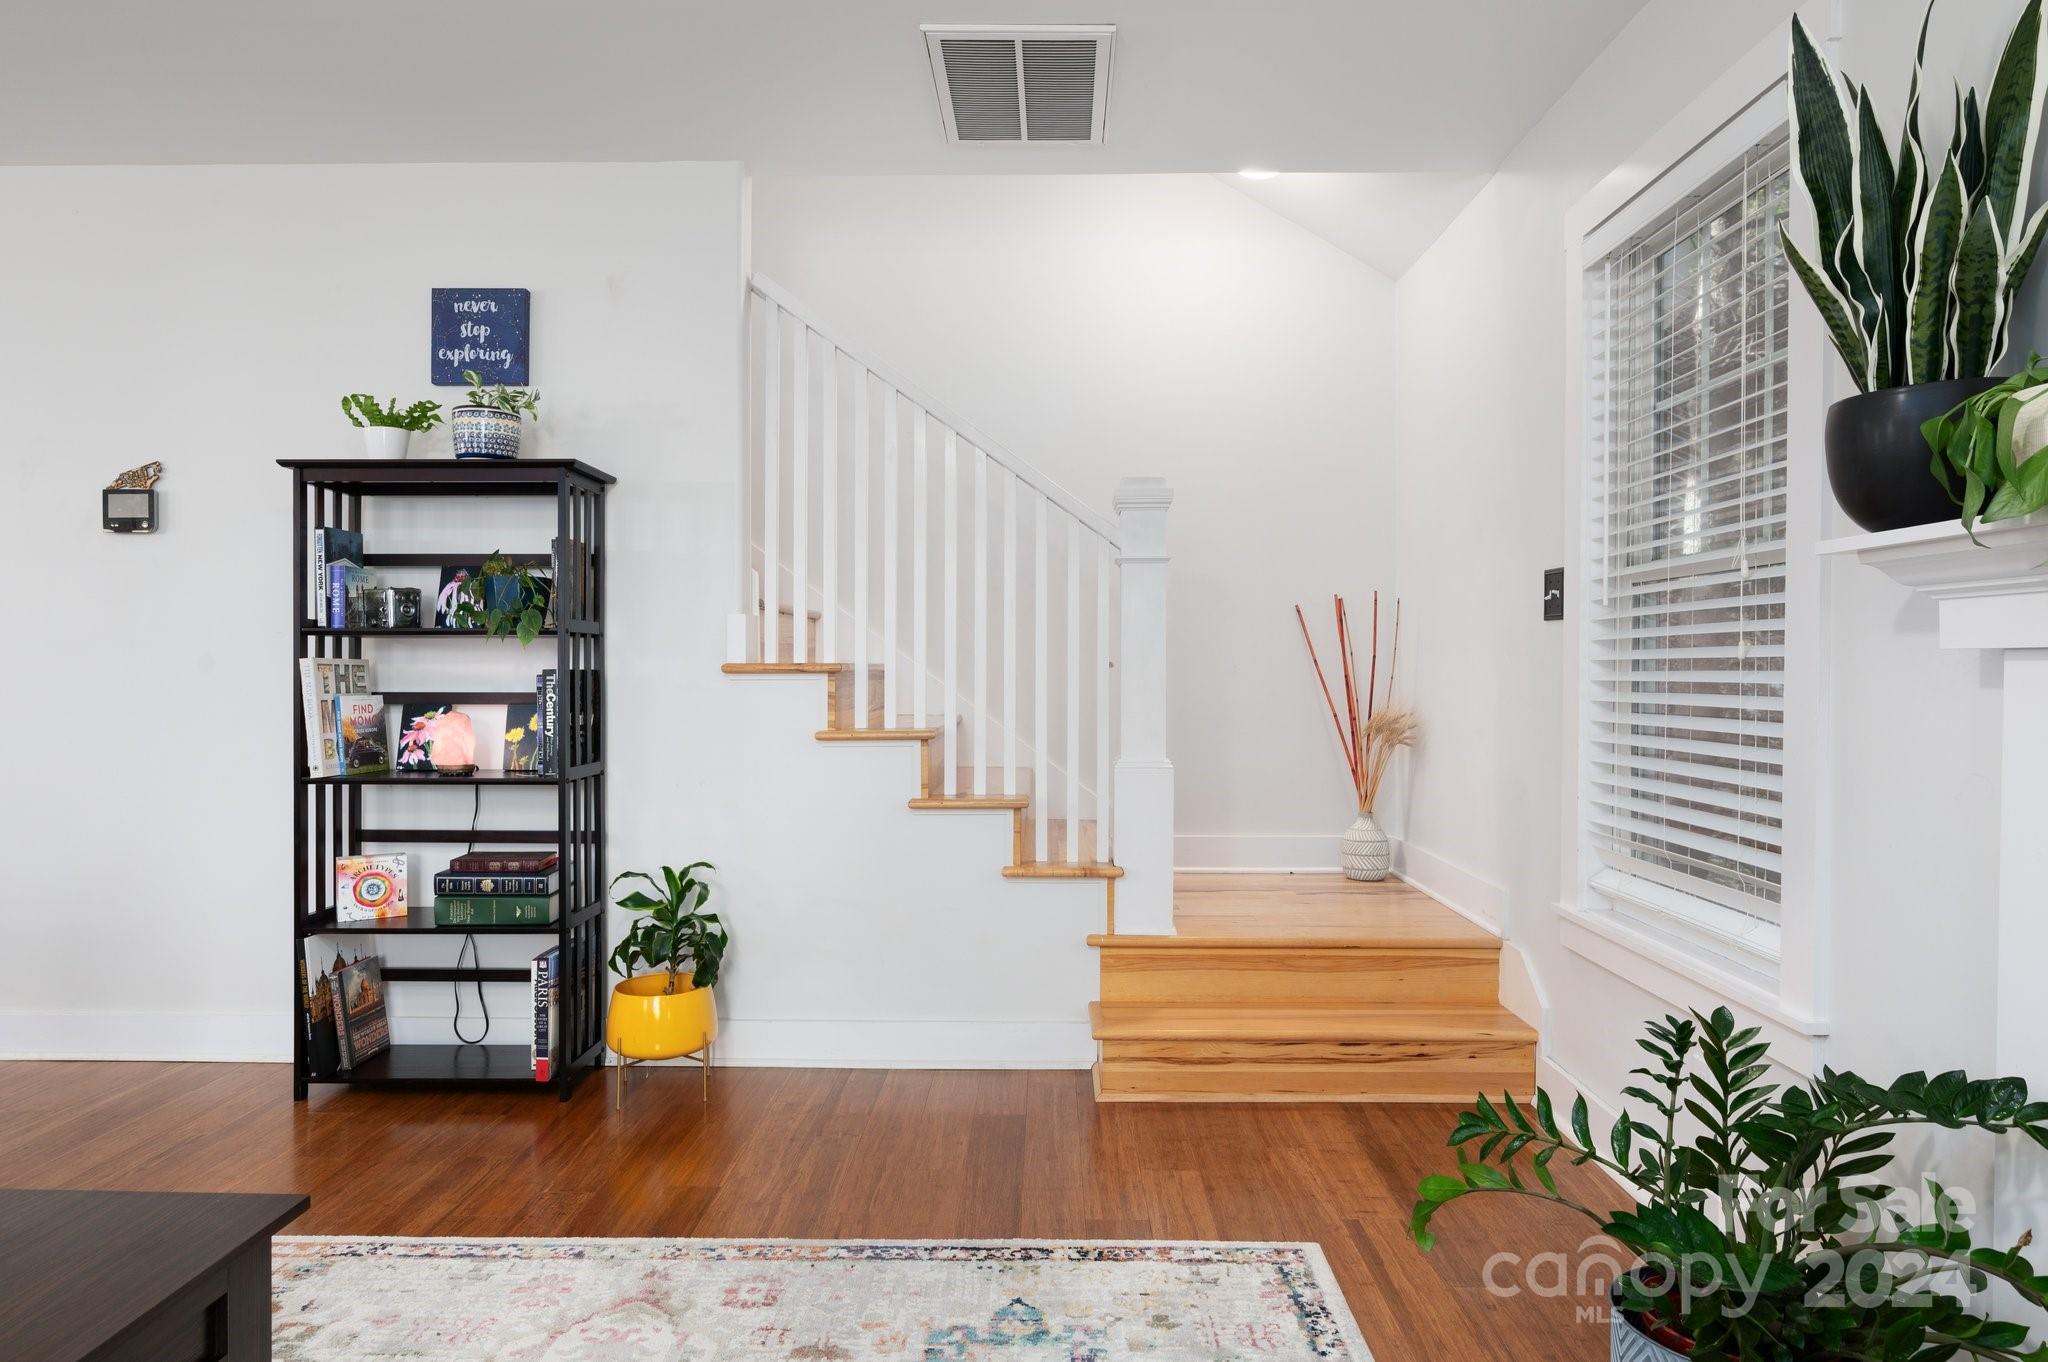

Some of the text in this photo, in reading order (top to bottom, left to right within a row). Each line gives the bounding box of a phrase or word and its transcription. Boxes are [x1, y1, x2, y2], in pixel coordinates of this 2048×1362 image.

[454, 300, 498, 313] never
[460, 321, 490, 343] stop
[438, 344, 513, 369] exploring
[352, 574, 369, 584] ROME
[332, 582, 340, 614] ROME
[317, 663, 367, 694] THE
[350, 715, 379, 726] MOMO
[352, 704, 374, 714] FIND
[538, 971, 549, 1008] PARIS
[332, 991, 345, 1040] WONDERS
